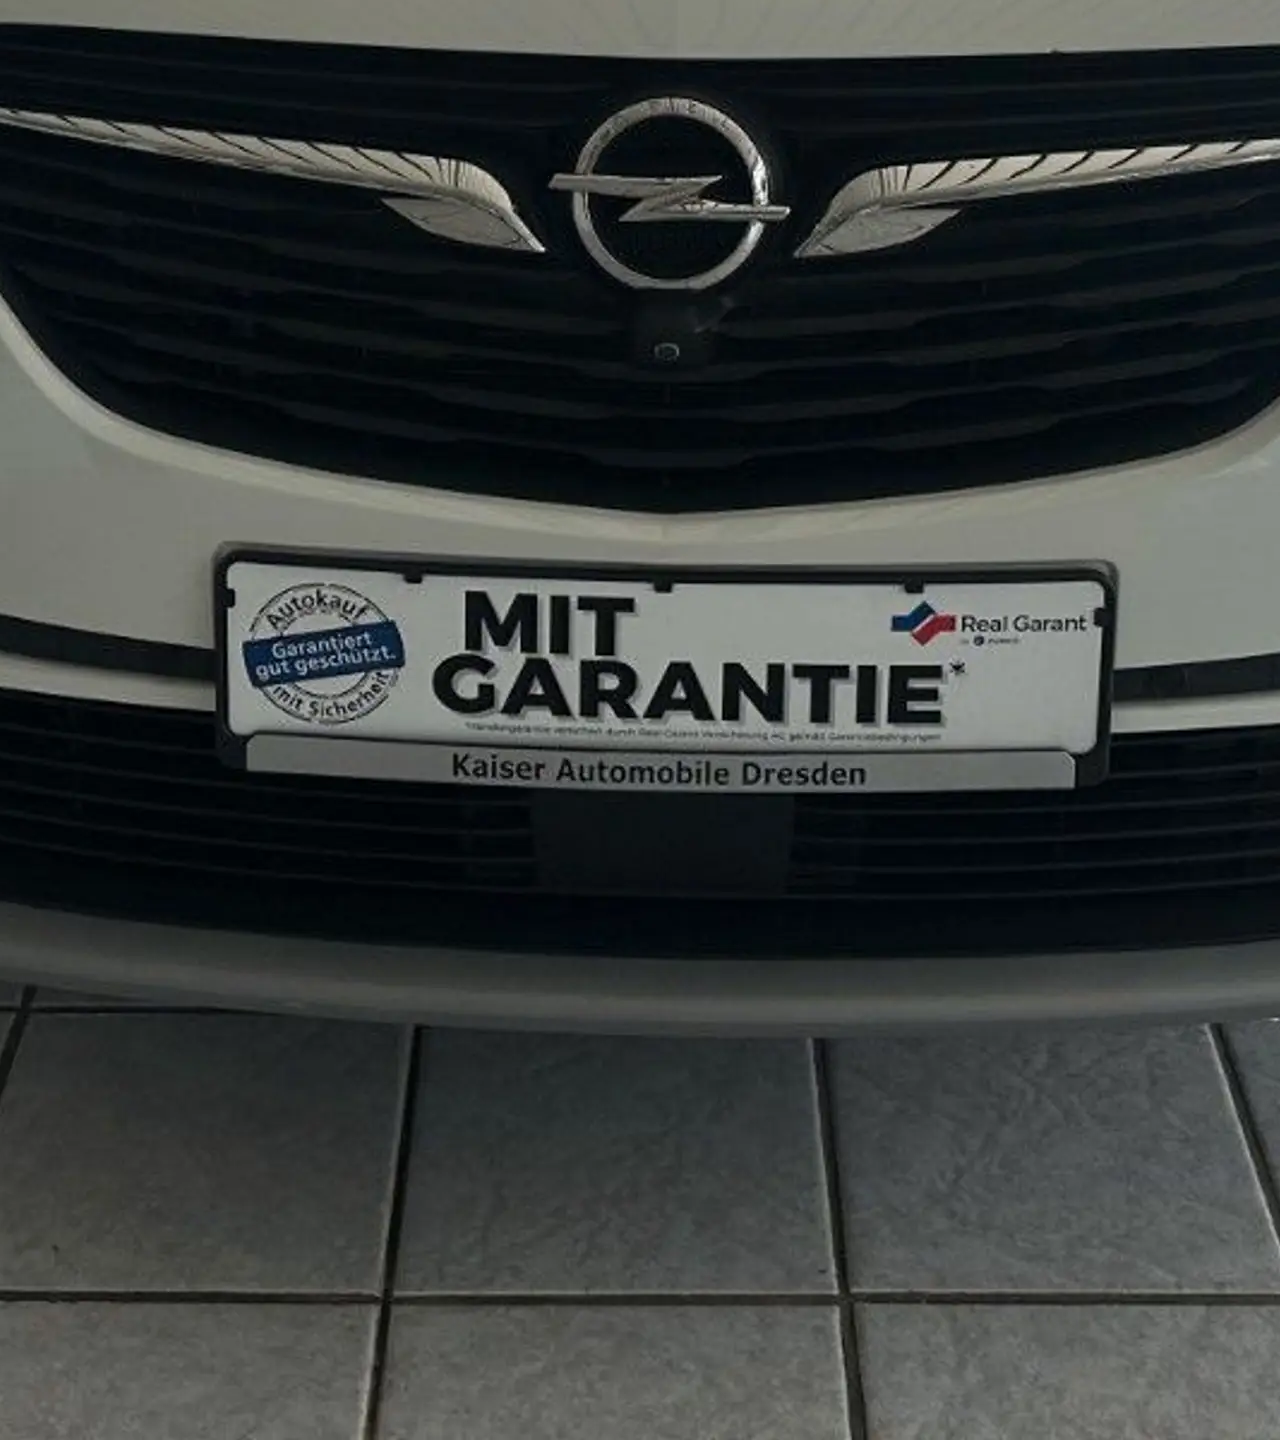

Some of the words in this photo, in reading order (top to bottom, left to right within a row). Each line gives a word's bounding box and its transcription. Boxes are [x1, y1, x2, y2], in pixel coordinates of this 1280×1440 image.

[267, 589, 369, 630] Autokauf
[465, 590, 635, 656] MIT
[961, 614, 1009, 633] Real
[1013, 614, 1088, 633] Garant
[271, 631, 373, 659] Garantiert
[255, 658, 292, 682] gut
[272, 685, 303, 711] mit
[308, 670, 390, 718] Sicherheit
[451, 753, 546, 781] Kaiser
[555, 756, 730, 787] Automobile
[742, 761, 868, 787] Dresden
